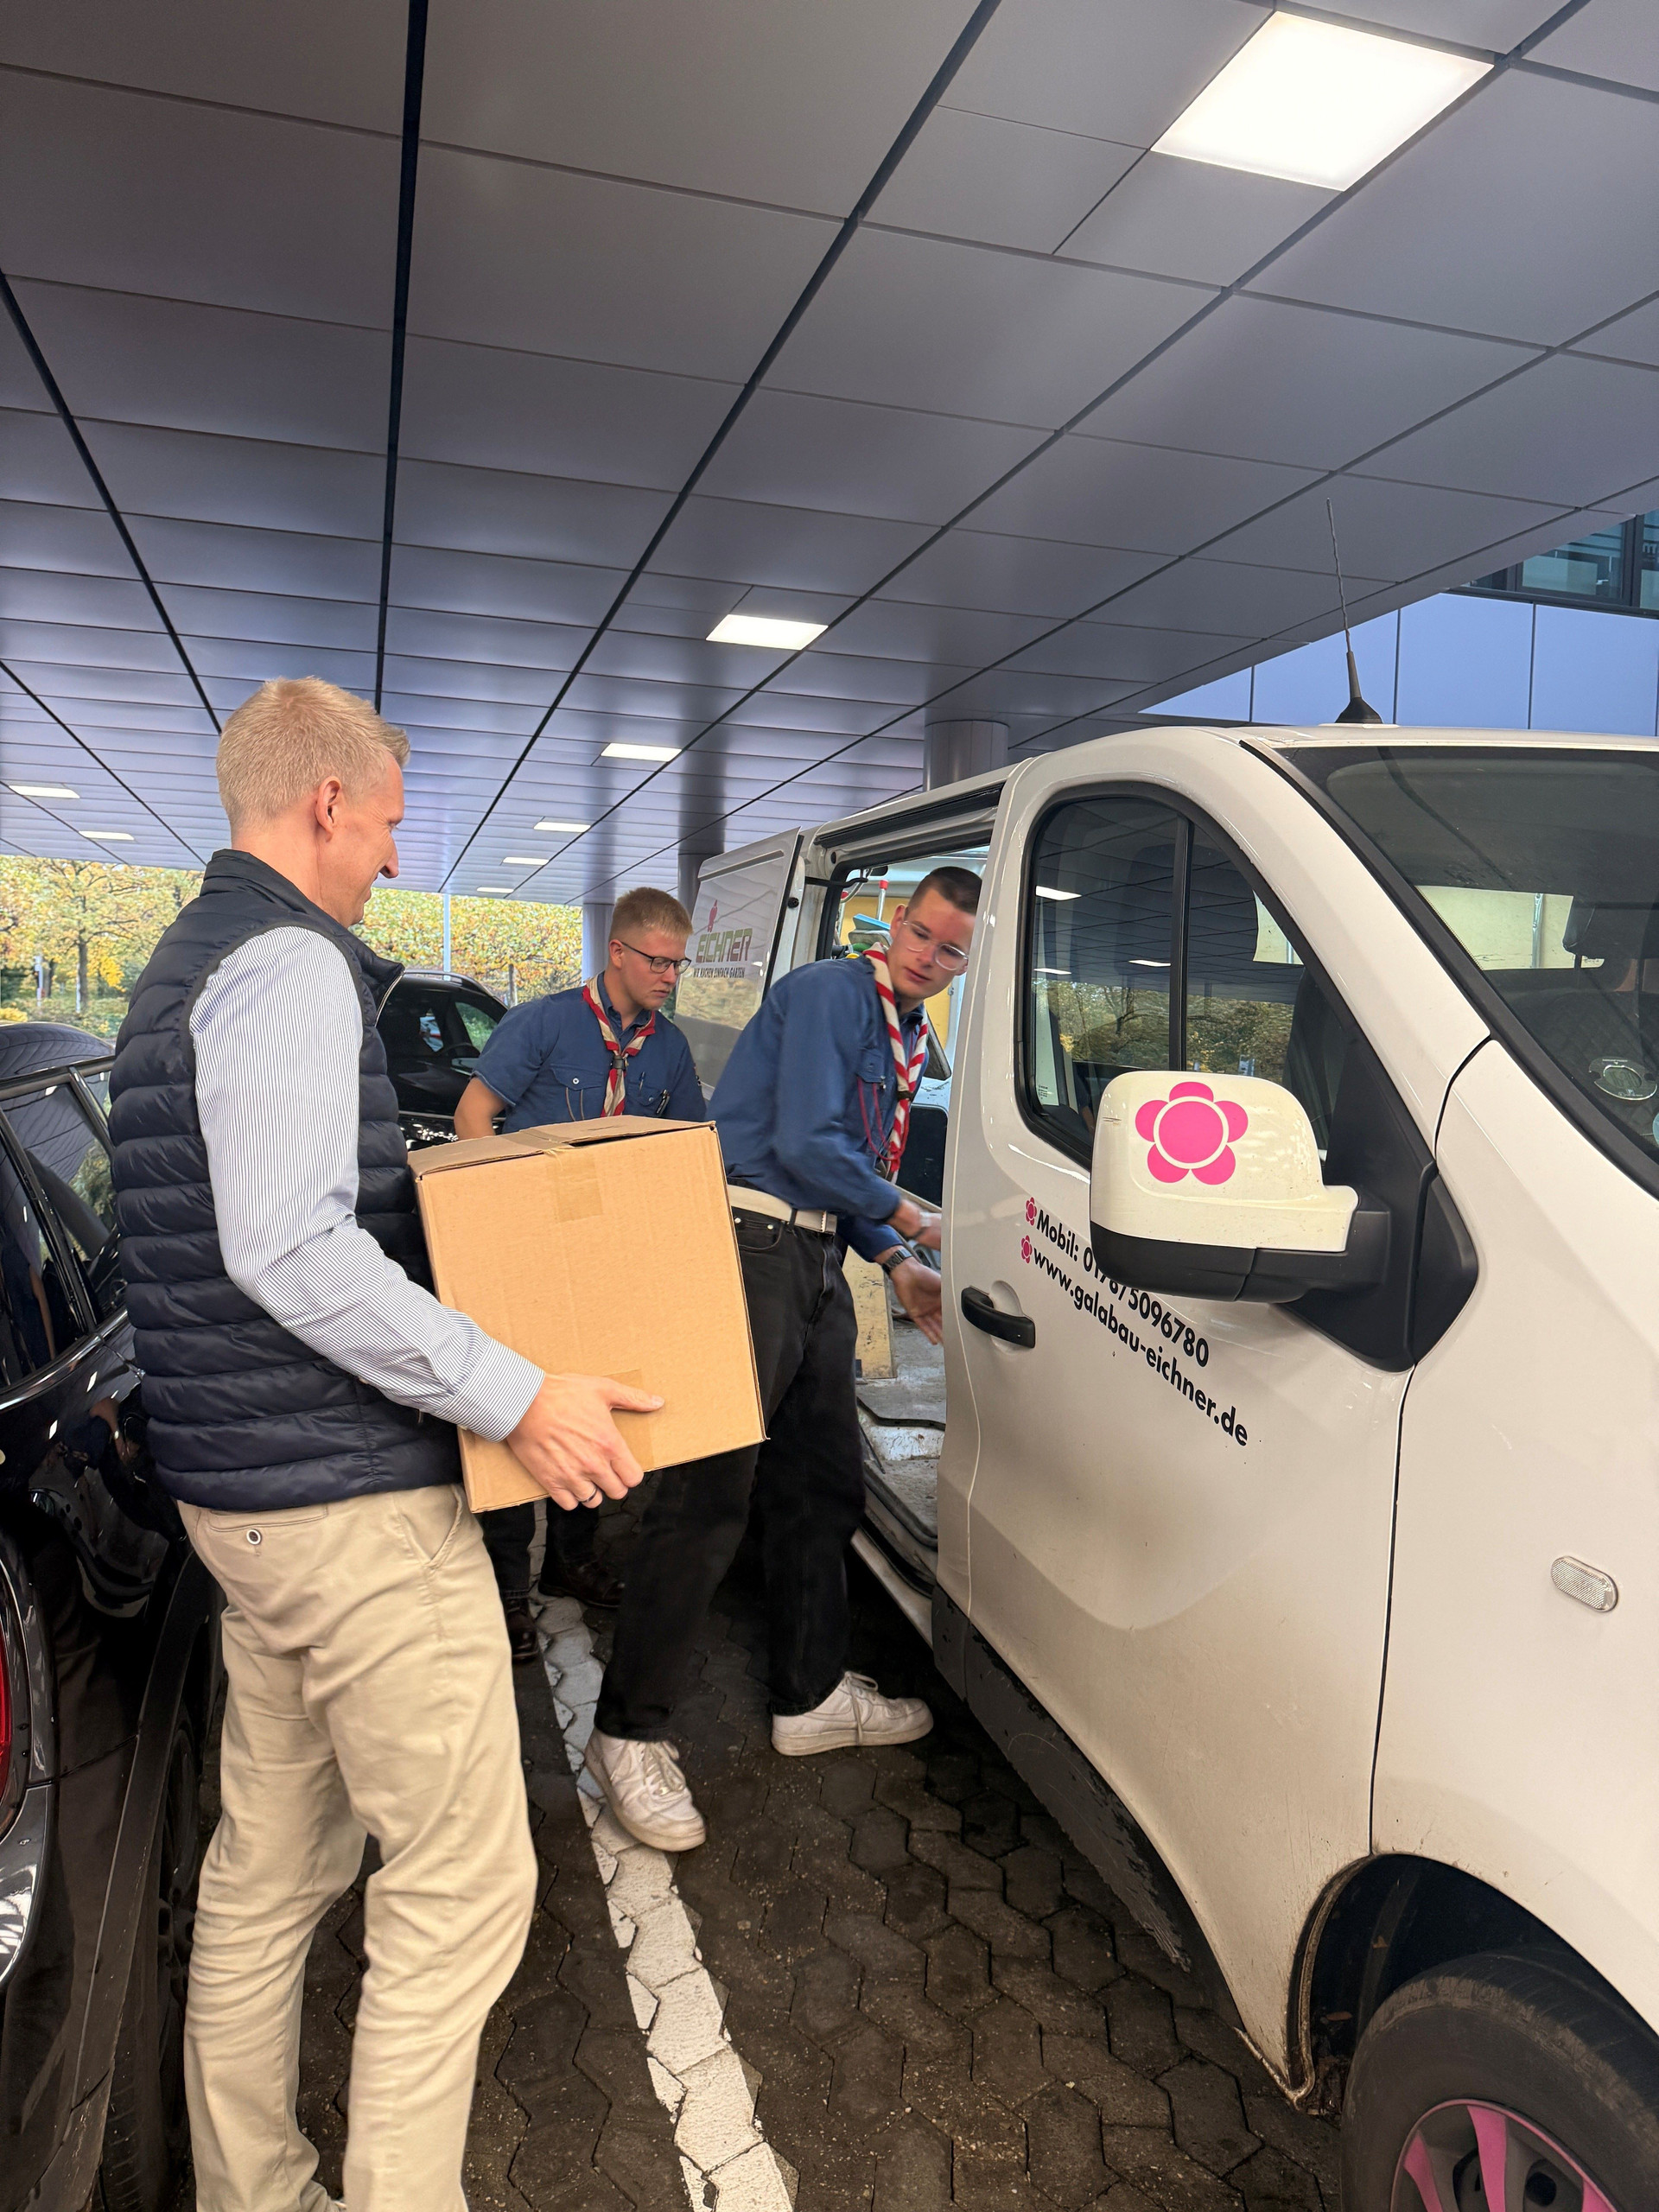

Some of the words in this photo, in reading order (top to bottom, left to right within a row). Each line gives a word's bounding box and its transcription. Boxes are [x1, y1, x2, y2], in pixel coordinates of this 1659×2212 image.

[696, 928, 753, 963] EICHNER
[1037, 1209, 1078, 1262] Mobil:
[1033, 1247, 1248, 1446] www.galabau-eichner.de
